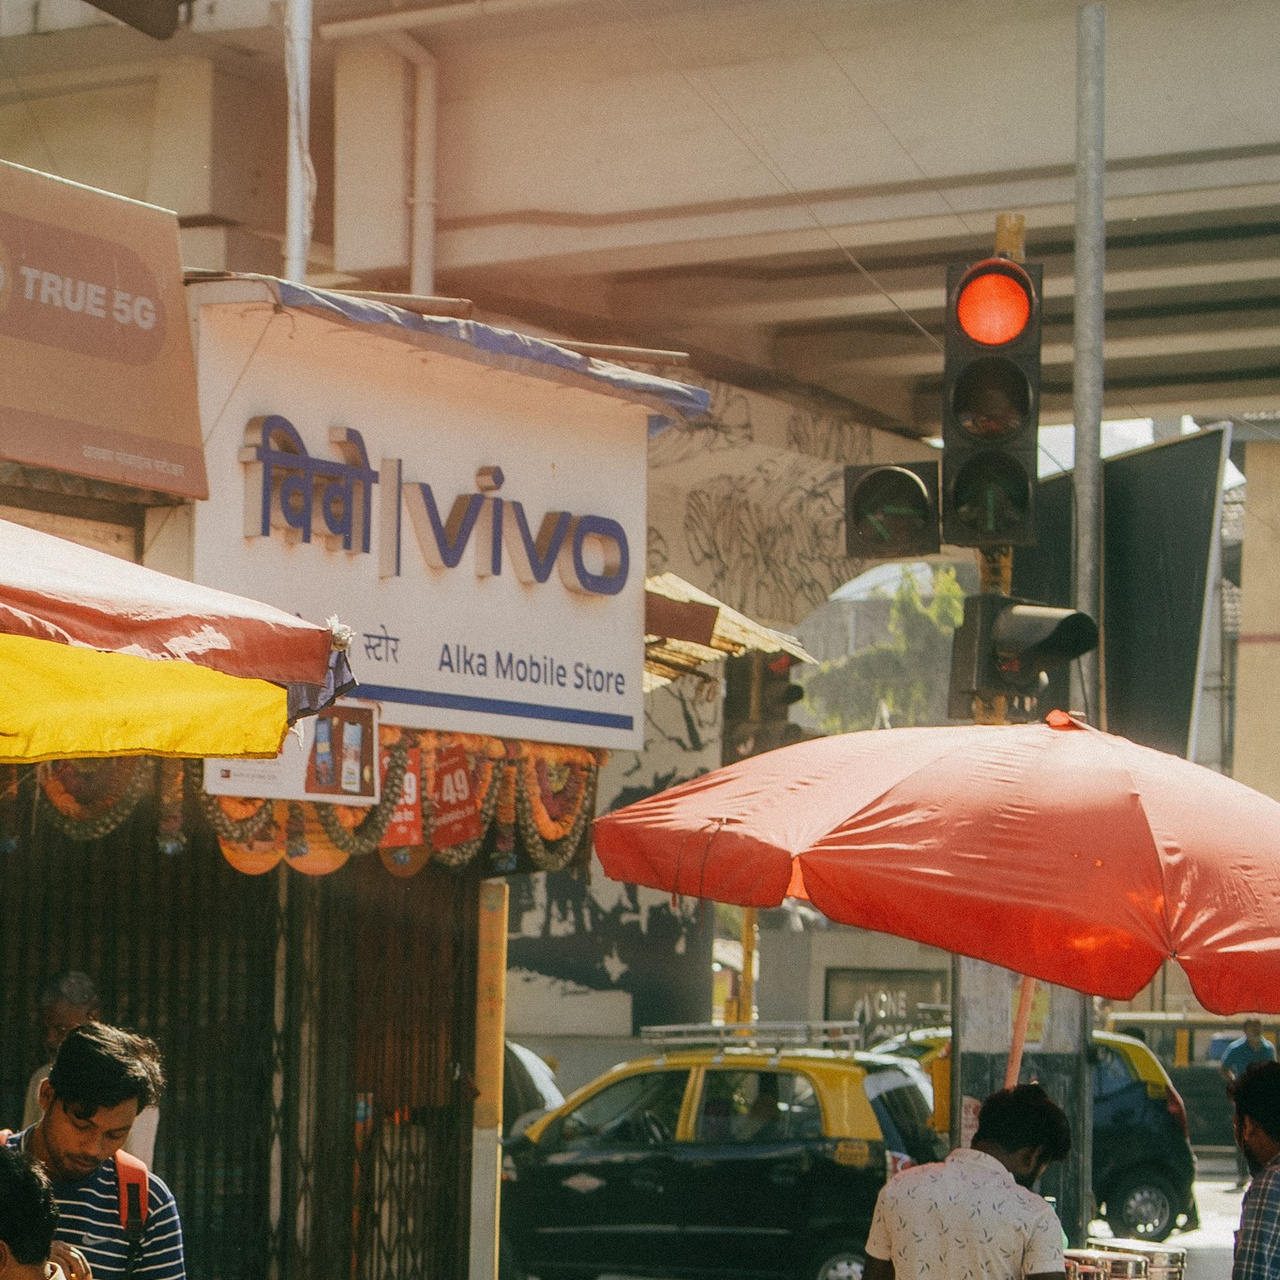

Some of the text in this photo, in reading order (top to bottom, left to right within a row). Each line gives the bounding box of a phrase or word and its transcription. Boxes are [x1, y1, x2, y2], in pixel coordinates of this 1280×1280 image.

[19, 265, 157, 330] TRUE 5G
[238, 414, 379, 555] विवो
[404, 464, 630, 597] vivo
[362, 623, 401, 664] स्टोर
[437, 642, 626, 696] Alka Mobile Store
